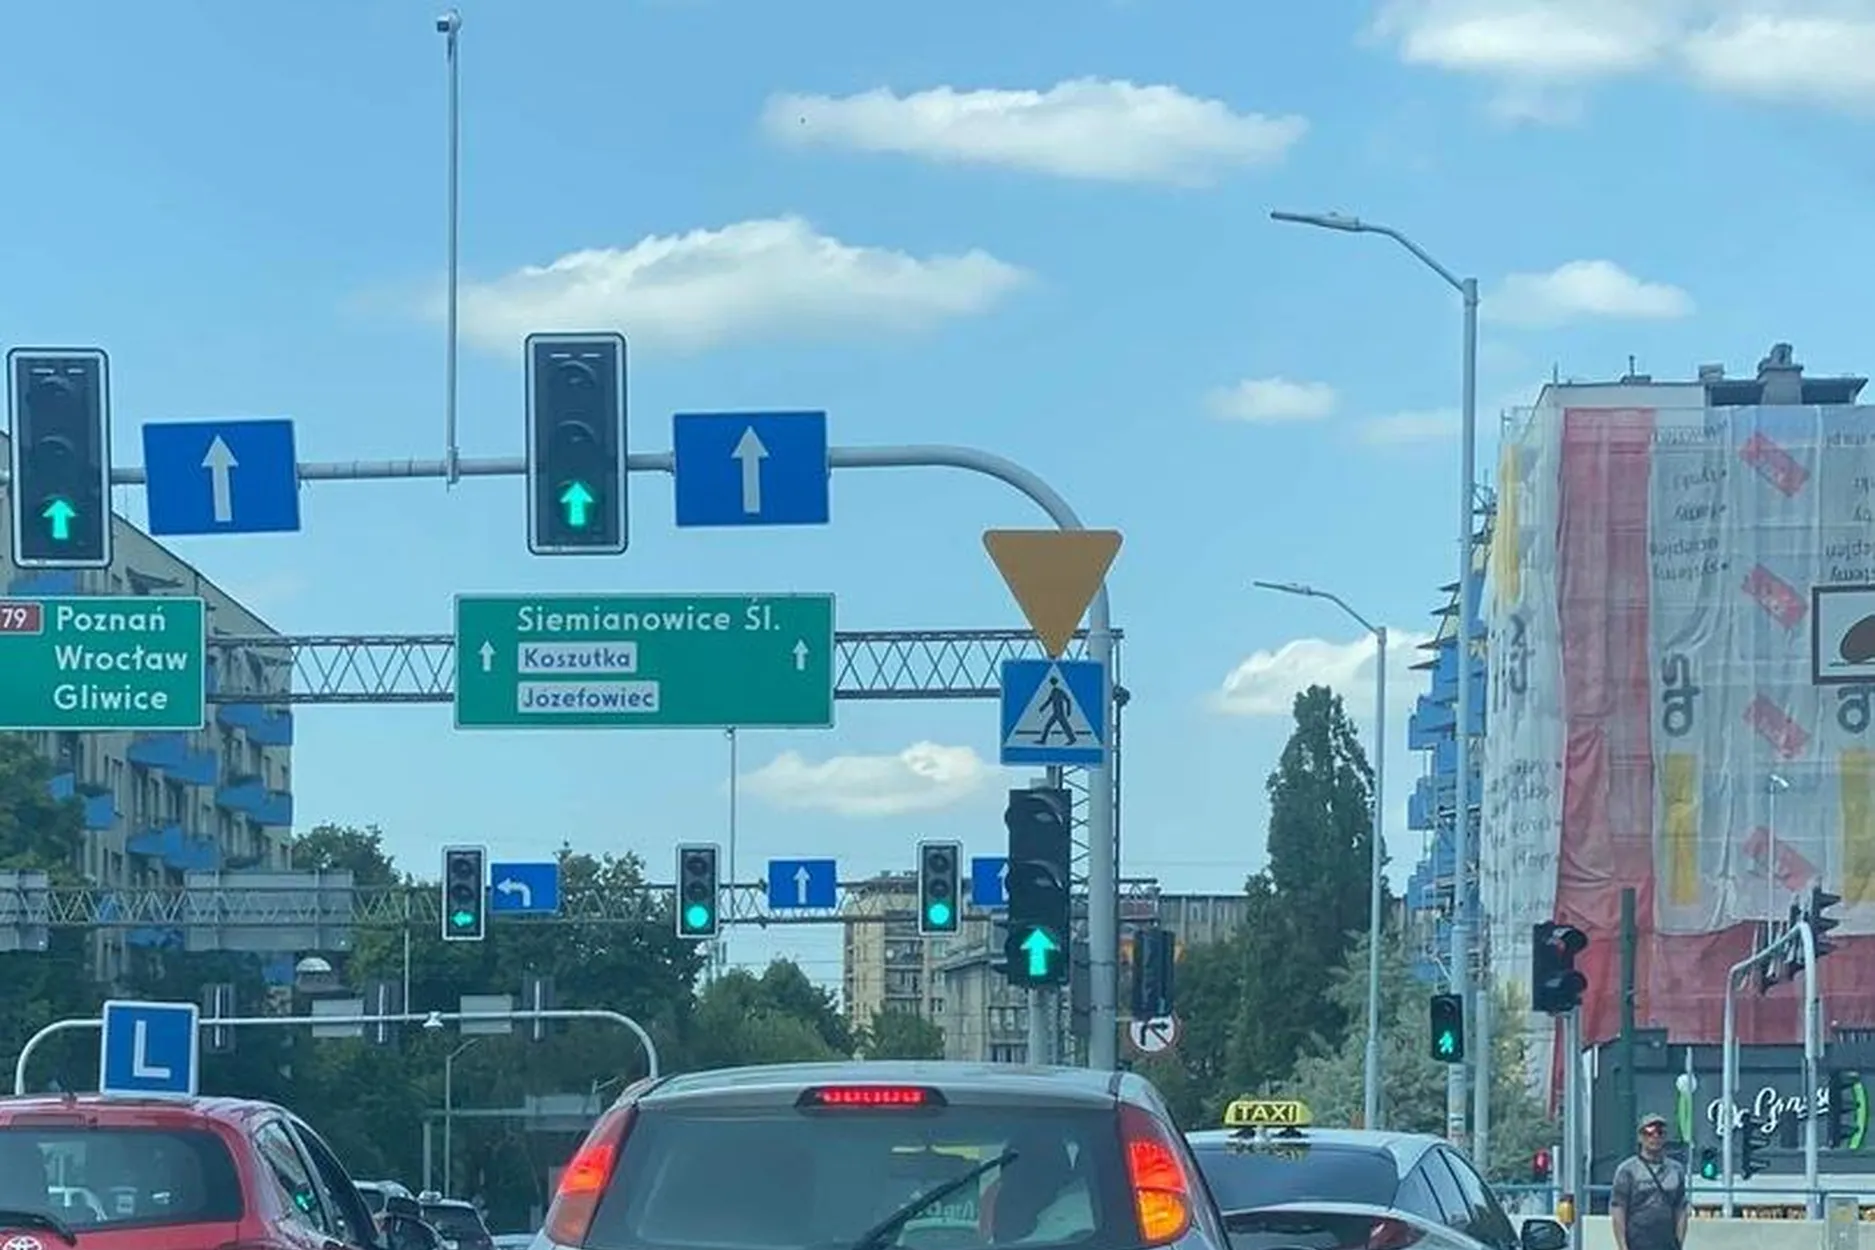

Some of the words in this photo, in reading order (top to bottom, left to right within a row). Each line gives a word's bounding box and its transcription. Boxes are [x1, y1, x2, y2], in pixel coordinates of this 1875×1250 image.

[1, 607, 28, 629] 79
[56, 605, 166, 632] Poznań
[517, 605, 731, 632] Siemianowice
[744, 597, 780, 631] Śl.
[54, 643, 188, 671] Wrocław
[524, 648, 631, 668] Koszutka
[53, 684, 168, 710] Gliwice
[133, 1020, 171, 1079] L
[1238, 1105, 1295, 1122] TAXI
